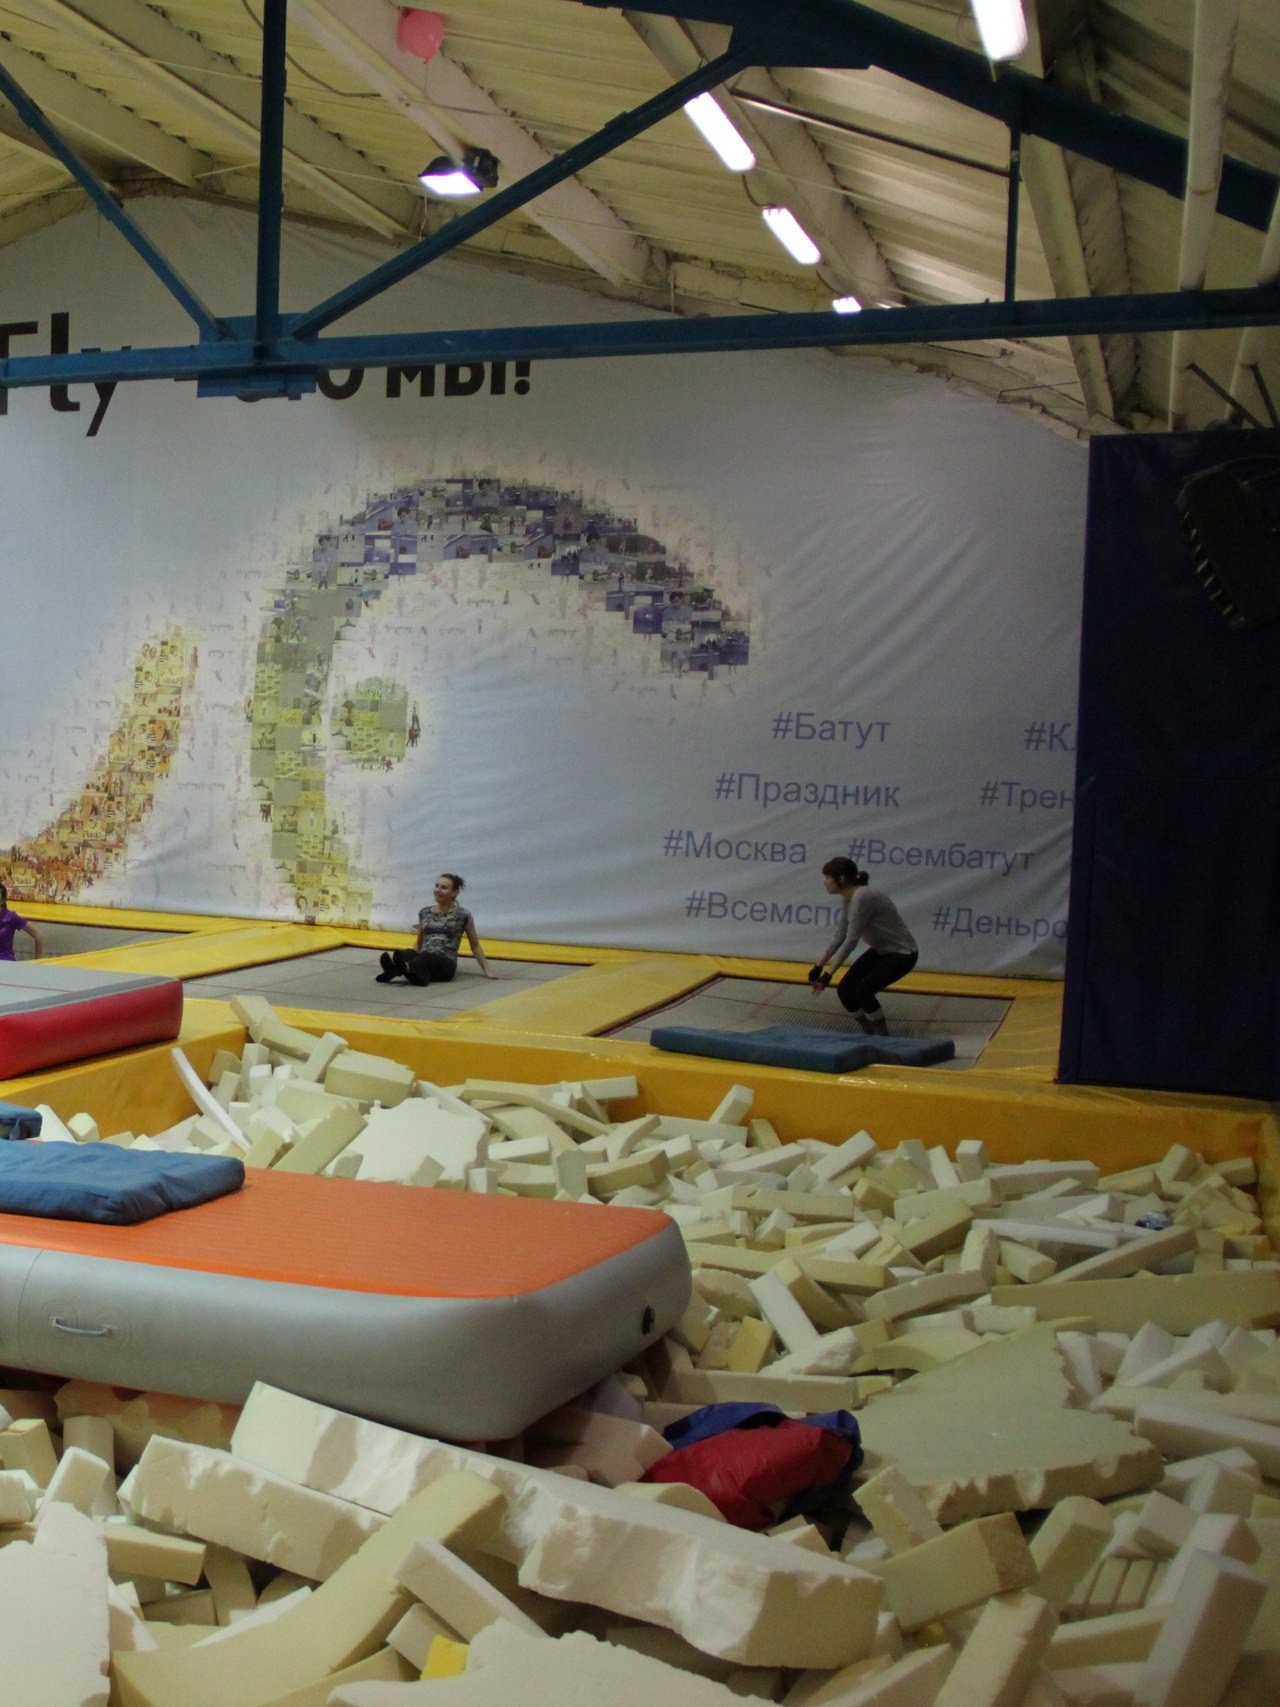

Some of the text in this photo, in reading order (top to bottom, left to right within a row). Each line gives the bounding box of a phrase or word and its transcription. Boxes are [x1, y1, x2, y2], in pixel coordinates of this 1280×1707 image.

[772, 711, 891, 749] #Батут
[1024, 721, 1077, 751] #К
[715, 772, 900, 810] #Праздник
[663, 829, 1035, 877] #Москва #Всембатут
